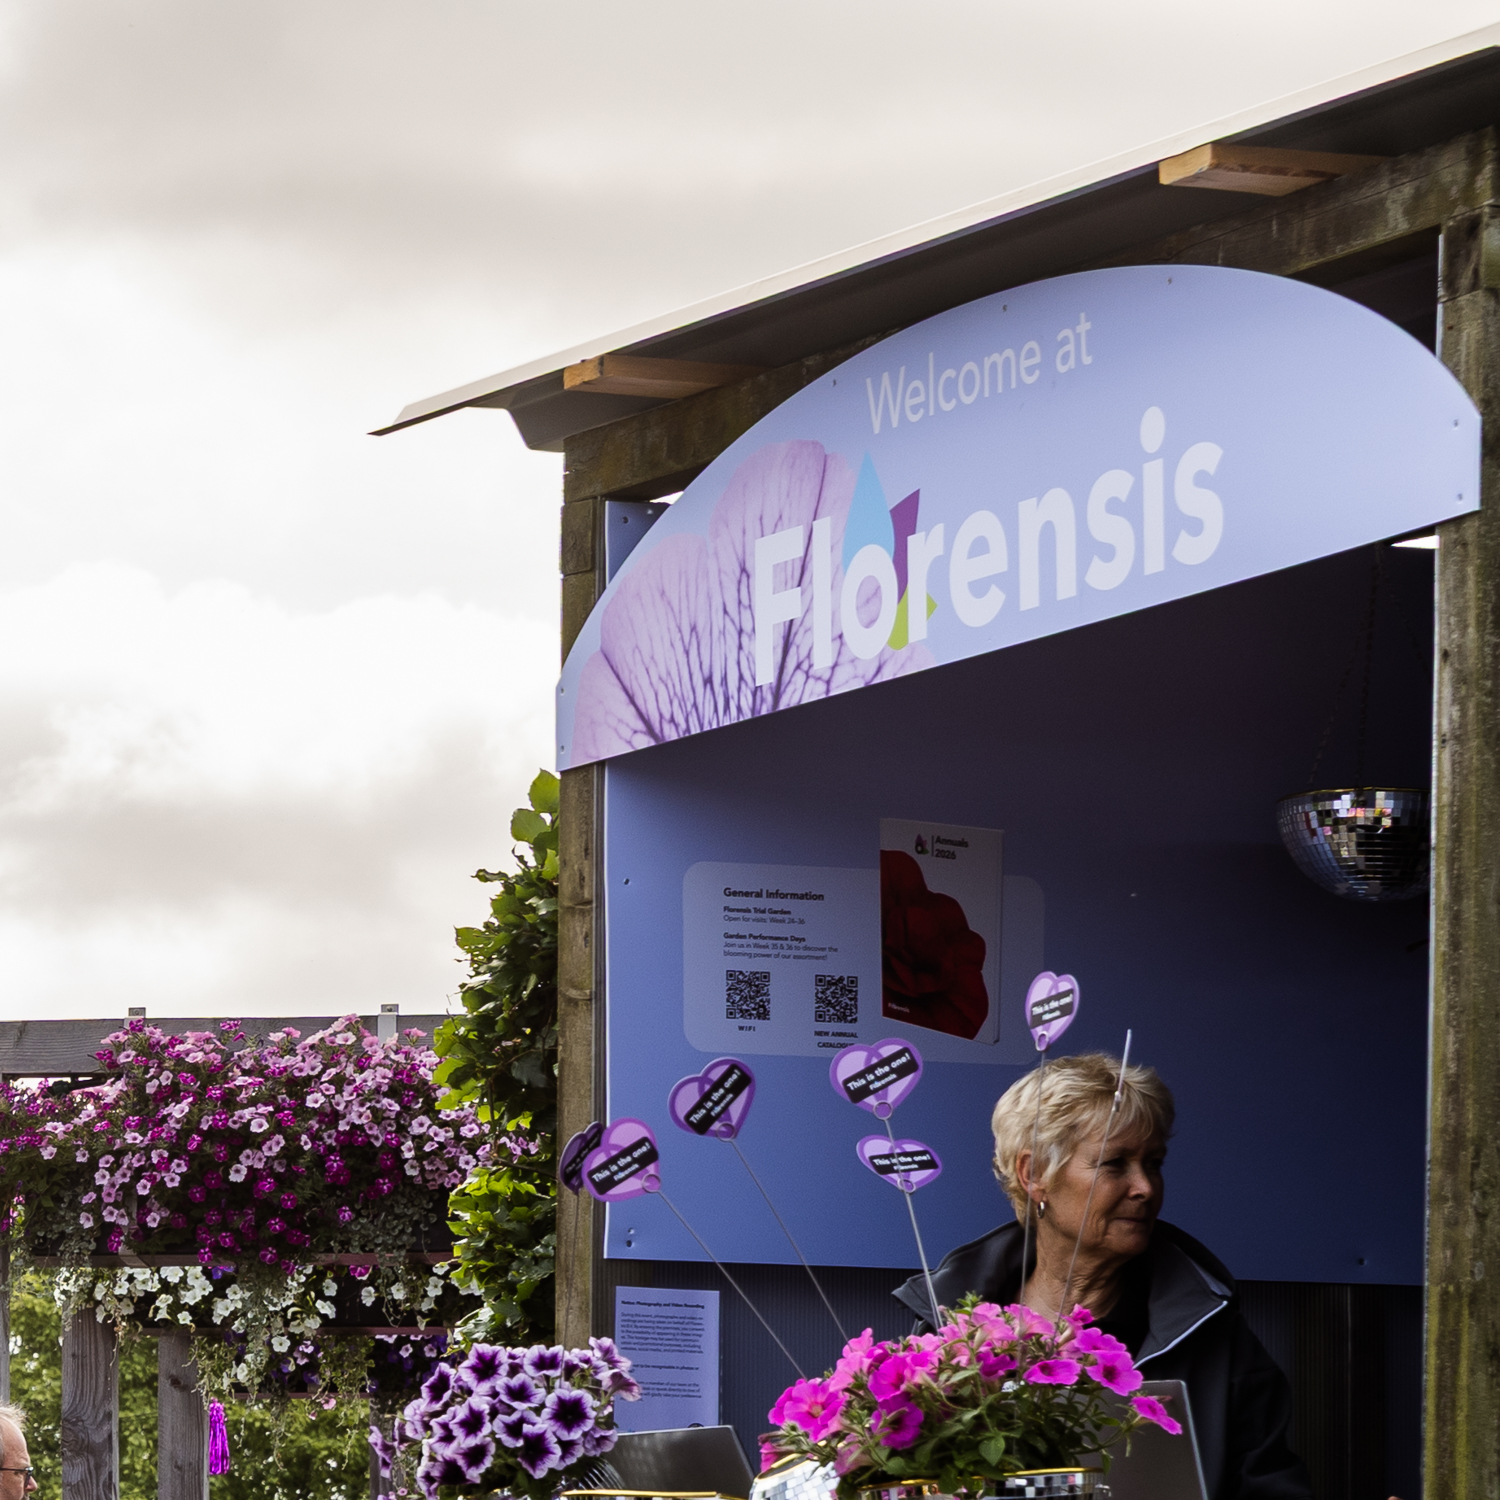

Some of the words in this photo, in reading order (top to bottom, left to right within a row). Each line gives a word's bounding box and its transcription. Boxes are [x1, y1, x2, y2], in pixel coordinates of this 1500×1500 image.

[865, 336, 1042, 435] Welcome
[1056, 312, 1093, 378] at
[754, 406, 1225, 686] Florensis
[935, 836, 969, 848] Annuals
[935, 849, 956, 860] 2026
[723, 887, 763, 899] General
[766, 889, 825, 901] Information
[723, 906, 752, 914] Florensis
[753, 907, 767, 915] Trial
[768, 908, 792, 916] Garden
[723, 915, 741, 923] Open
[723, 932, 747, 940] Garden
[748, 933, 789, 941] Performance
[790, 936, 806, 944] Days
[752, 942, 770, 950] Week
[802, 944, 827, 952] discover
[828, 945, 838, 953] the
[723, 949, 752, 959] blooming
[753, 952, 772, 960] power
[831, 1031, 859, 1039] ANNUAL
[846, 1078, 867, 1091] This
[865, 1073, 875, 1081] is
[874, 1065, 891, 1077] the
[891, 1052, 911, 1069] one!
[689, 1108, 707, 1124] This
[703, 1101, 713, 1109] is
[711, 1088, 725, 1101] the
[724, 1069, 741, 1088] one!
[592, 1170, 611, 1183] This
[608, 1164, 618, 1173] is
[616, 1156, 632, 1167] the
[632, 1142, 651, 1158] one!
[872, 1158, 891, 1166] This
[913, 1153, 931, 1162] one!
